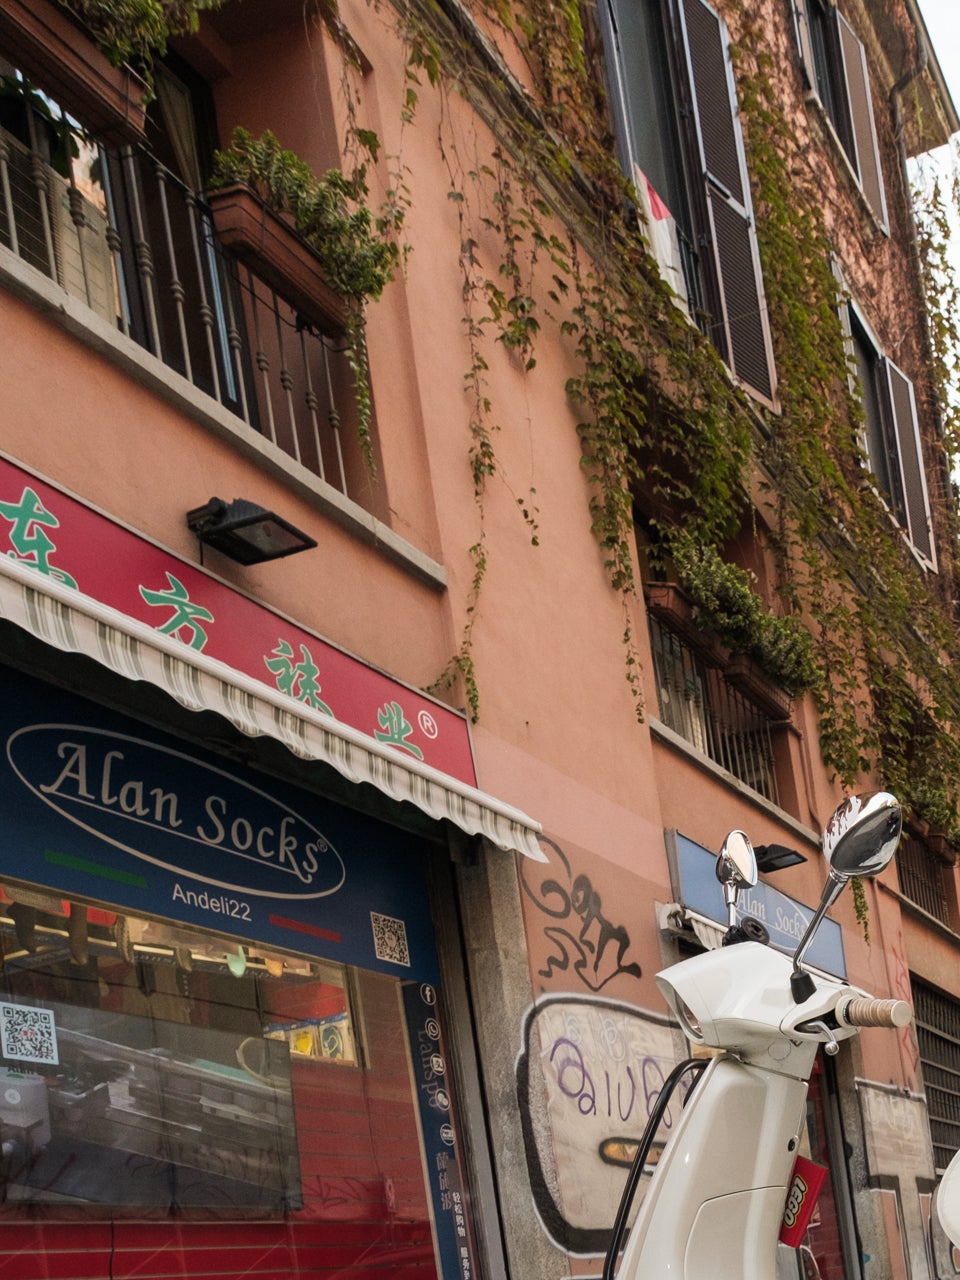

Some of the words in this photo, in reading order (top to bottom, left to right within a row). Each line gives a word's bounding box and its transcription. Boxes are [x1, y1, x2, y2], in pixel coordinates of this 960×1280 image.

[39, 742, 182, 827] Alan
[197, 796, 319, 884] Socks
[172, 884, 252, 922] Andeli22
[736, 888, 766, 920] Alan
[775, 907, 806, 938] Socks
[783, 1174, 808, 1228] LEGO
